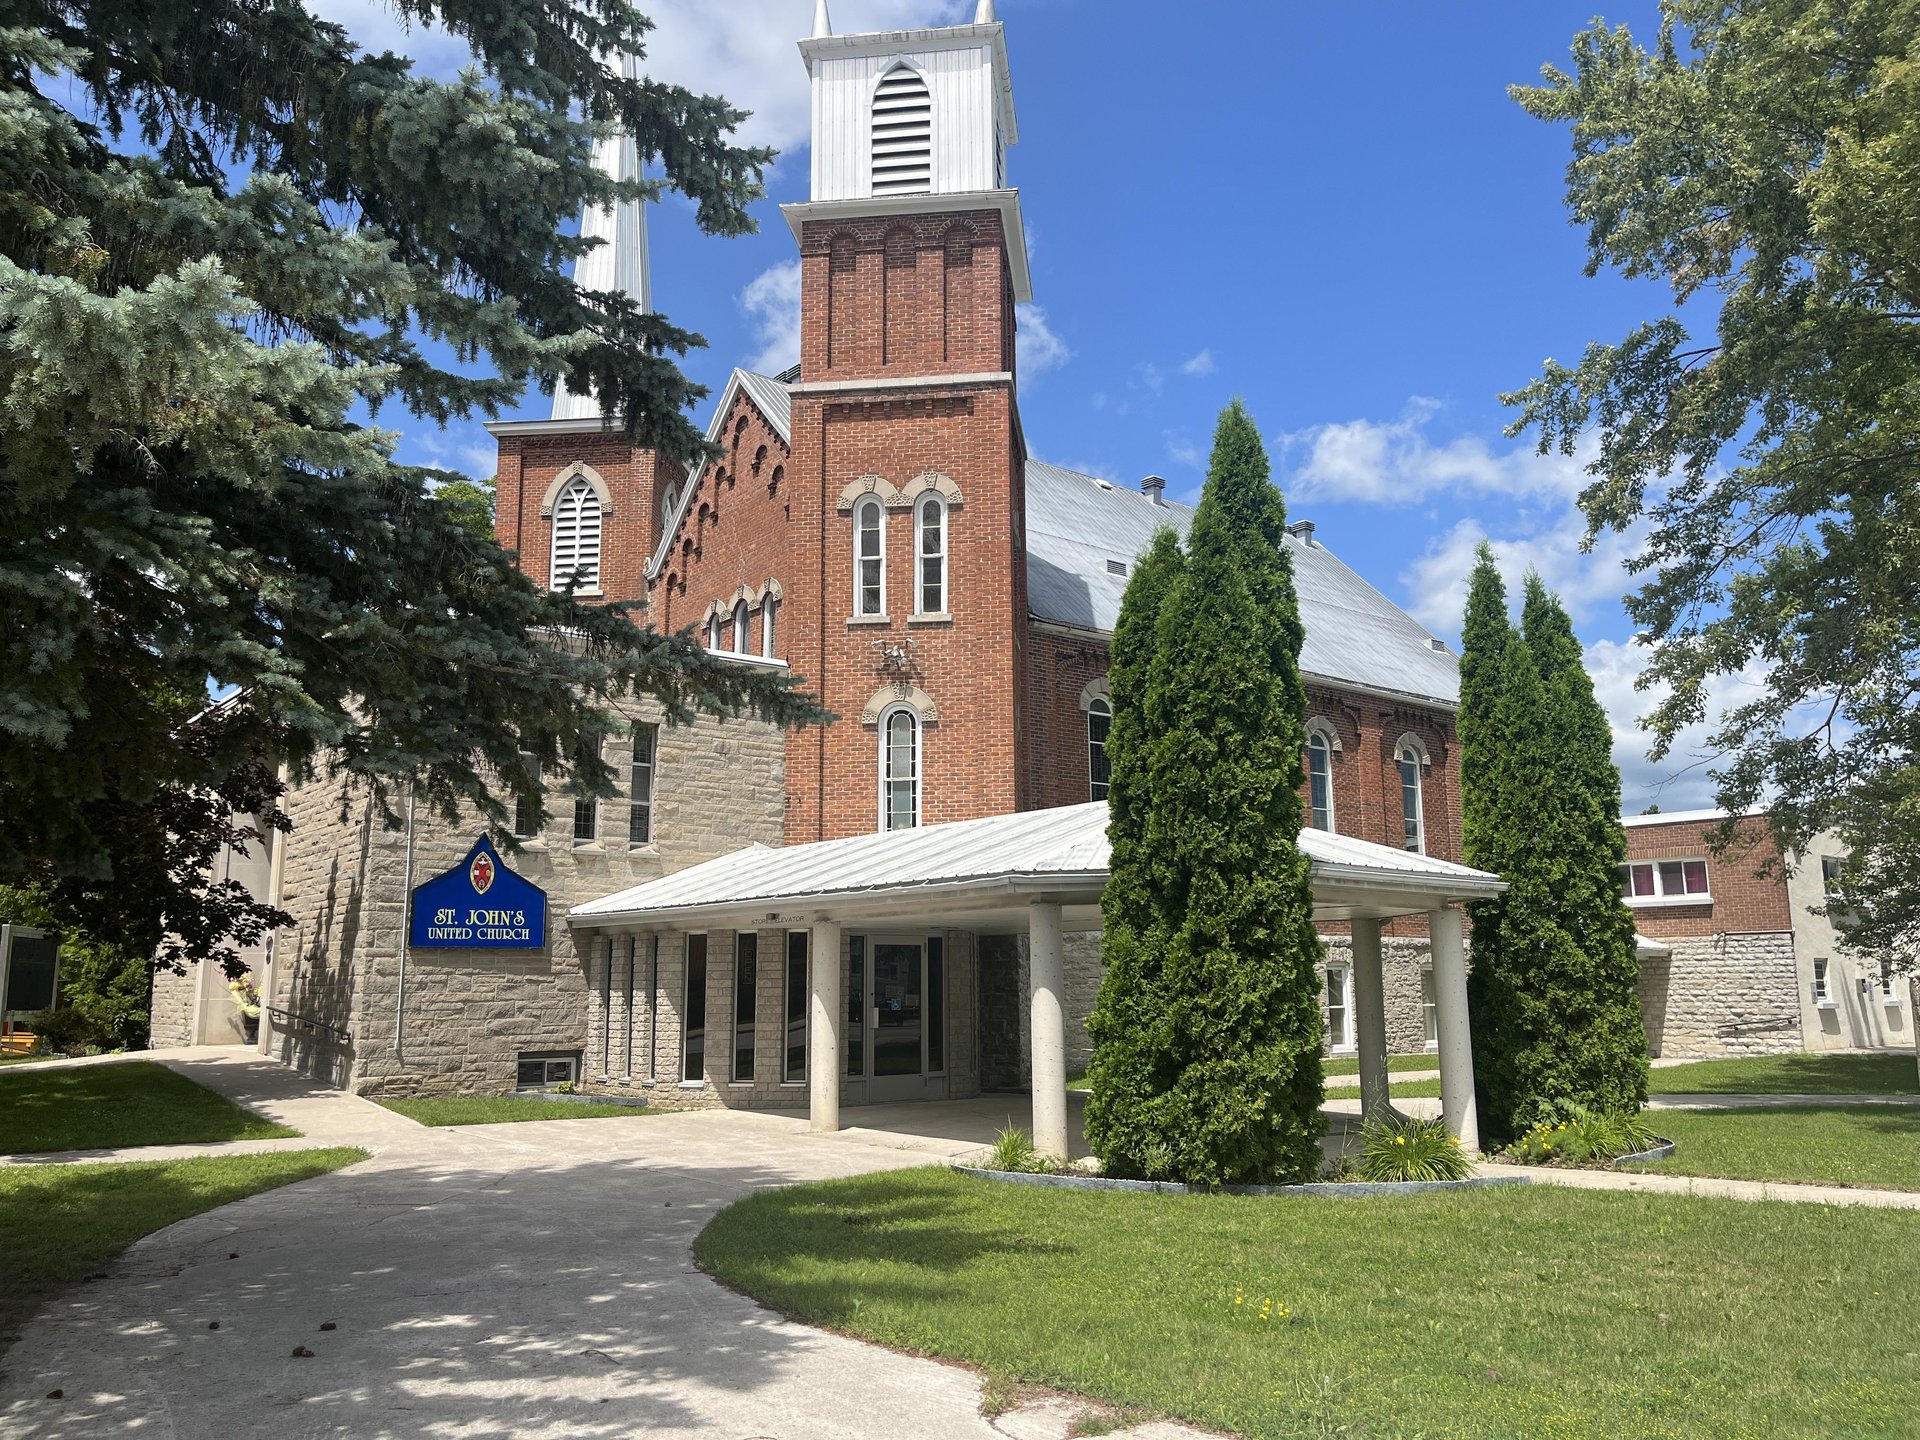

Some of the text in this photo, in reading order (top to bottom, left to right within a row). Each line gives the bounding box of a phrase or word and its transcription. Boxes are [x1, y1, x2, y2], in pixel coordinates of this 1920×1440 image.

[434, 908, 525, 926] ST. JOHN'S
[428, 927, 530, 940] UNITED CHURCH
